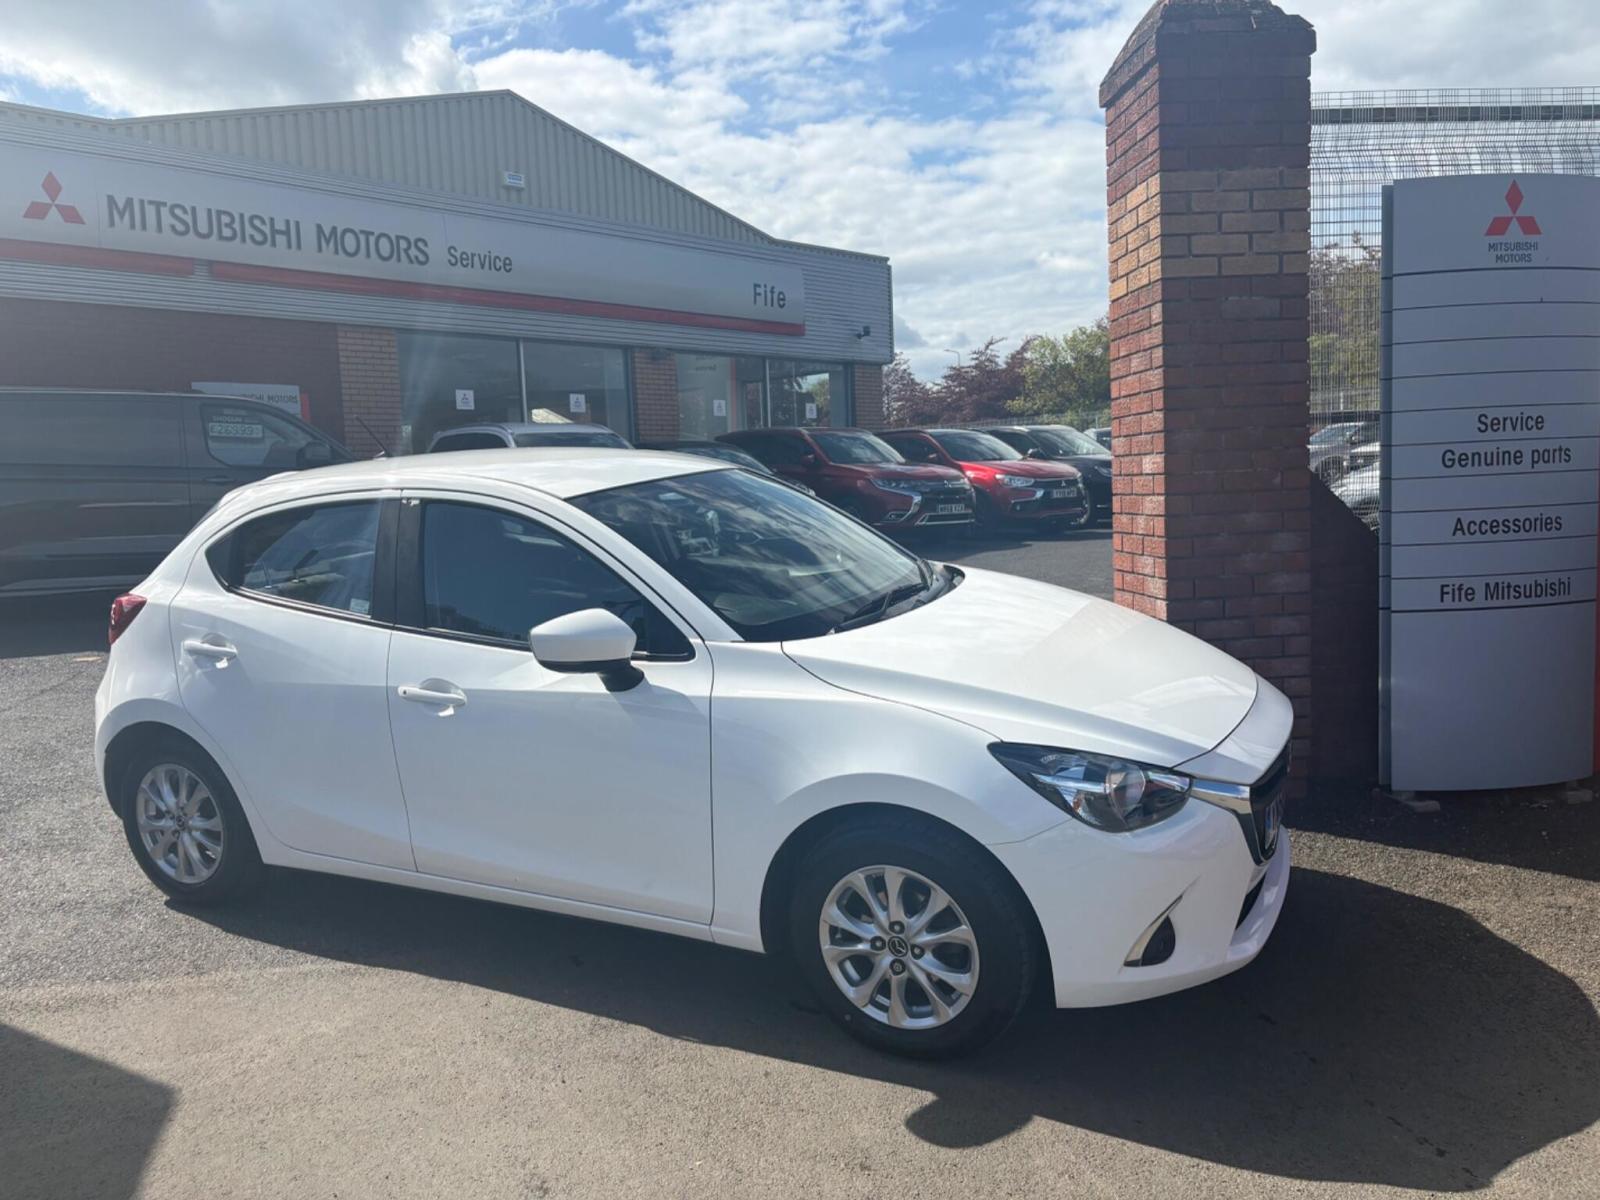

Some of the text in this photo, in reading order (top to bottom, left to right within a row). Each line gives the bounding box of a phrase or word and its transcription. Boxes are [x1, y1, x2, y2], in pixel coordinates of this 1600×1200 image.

[106, 194, 513, 273] MITSUBISHI MOTORS Service
[1488, 241, 1538, 252] MITSUBISHI
[1495, 253, 1533, 263] MOTORS
[753, 282, 787, 309] Fife
[1477, 412, 1545, 433] Service
[1441, 444, 1572, 469] Genuine parts
[1452, 513, 1563, 537] Accessories
[1440, 577, 1572, 603] Fife Mitsubishi
